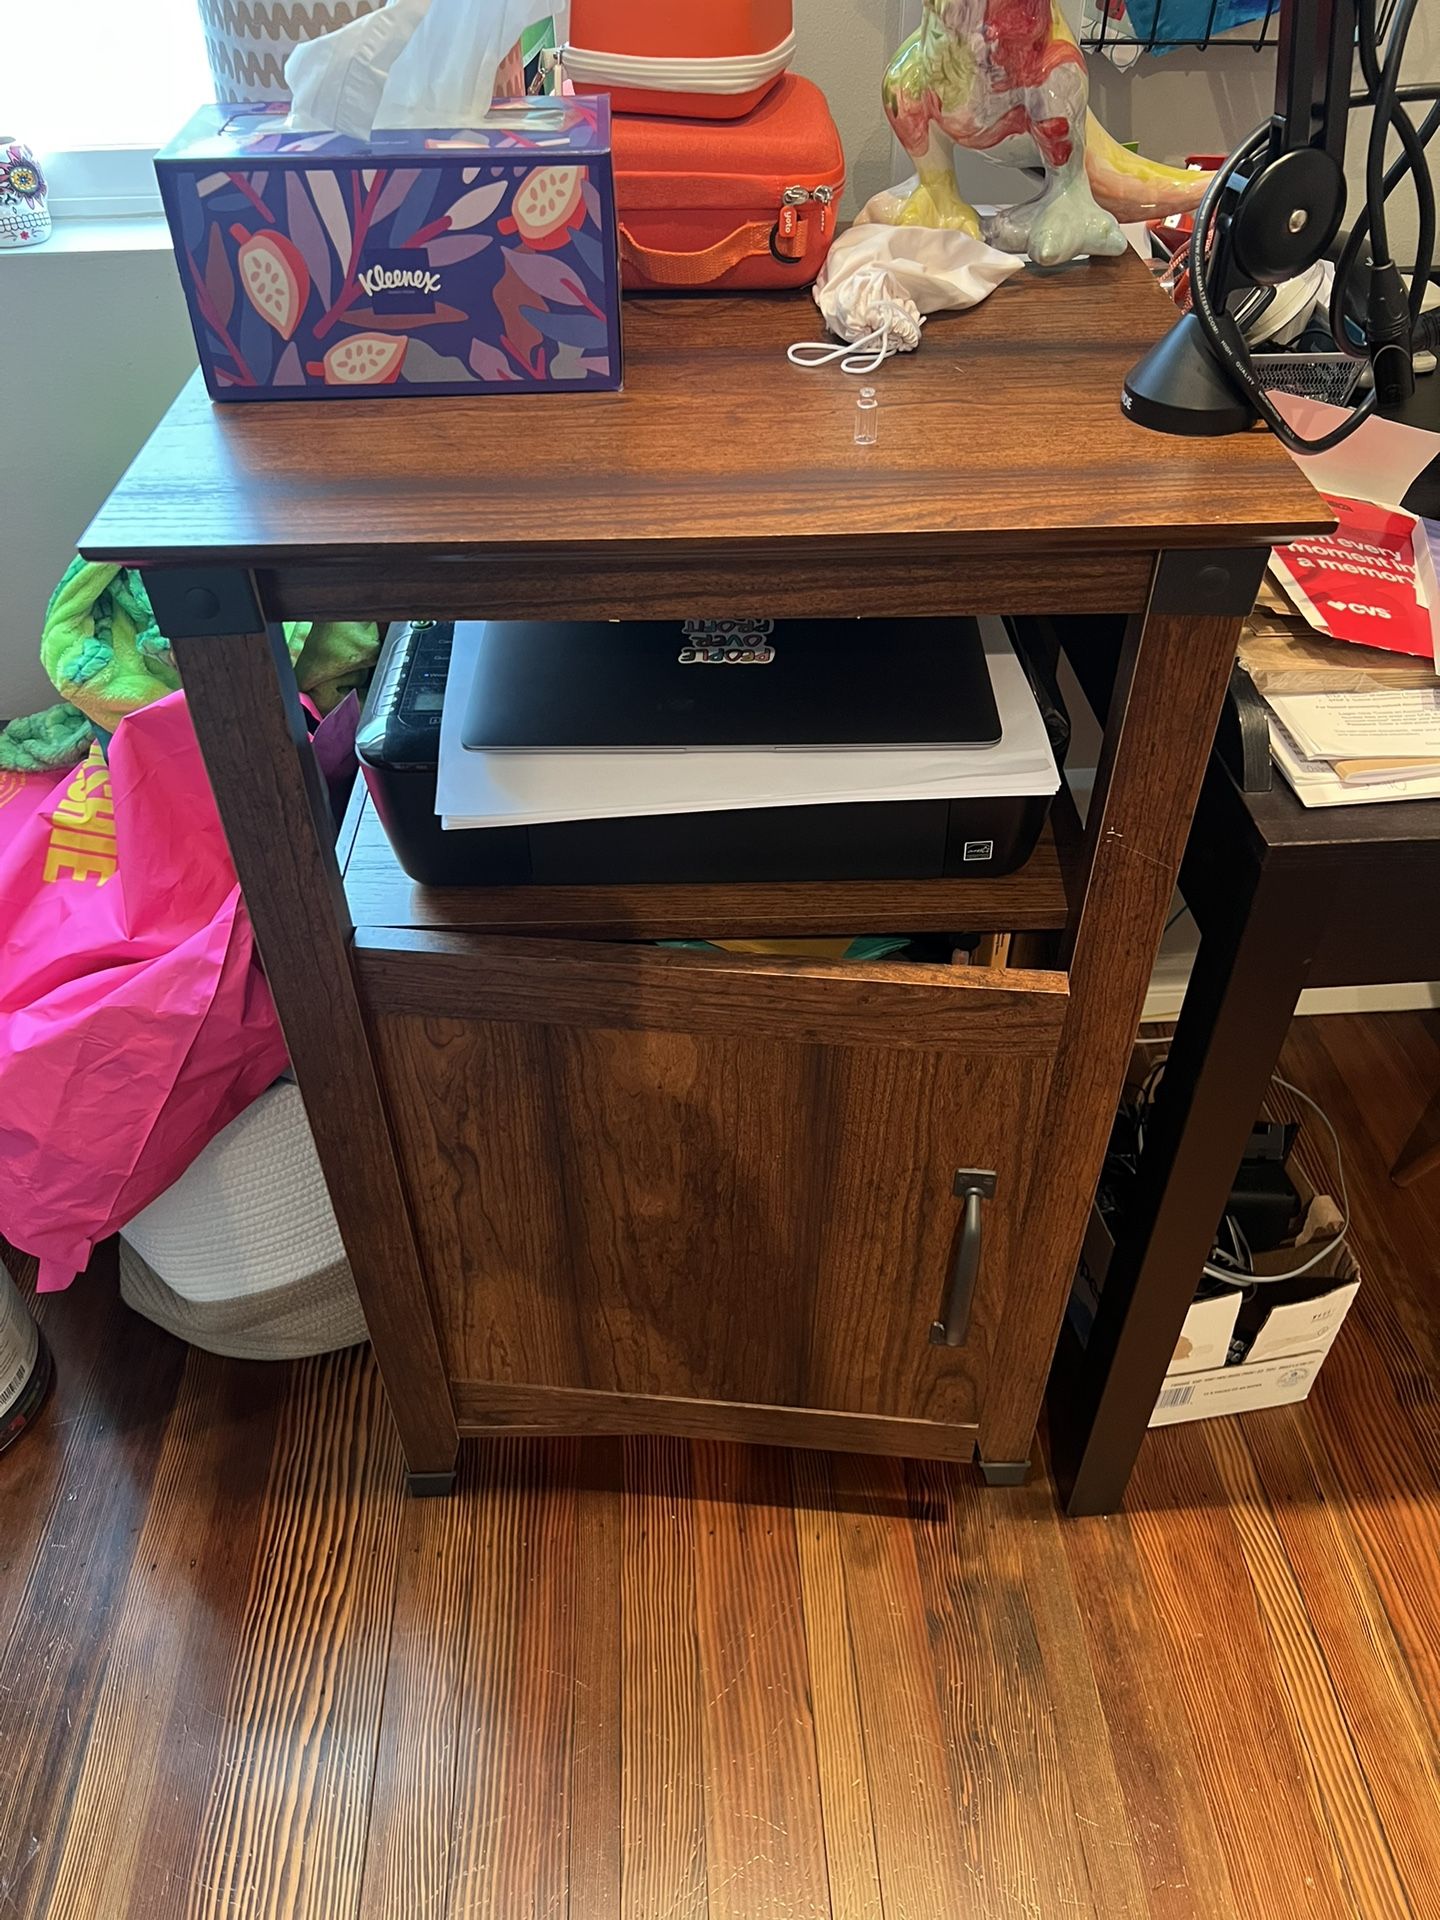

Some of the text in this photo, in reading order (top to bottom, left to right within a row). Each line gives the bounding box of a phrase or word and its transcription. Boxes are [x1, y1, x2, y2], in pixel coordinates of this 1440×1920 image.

[358, 265, 441, 296] Kleenex
[1287, 543, 1392, 568] moment
[1337, 537, 1401, 561] every
[1296, 557, 1315, 569] a
[1348, 602, 1392, 620] CVS
[690, 634, 763, 648] OVER
[680, 648, 771, 662] PEOPLE
